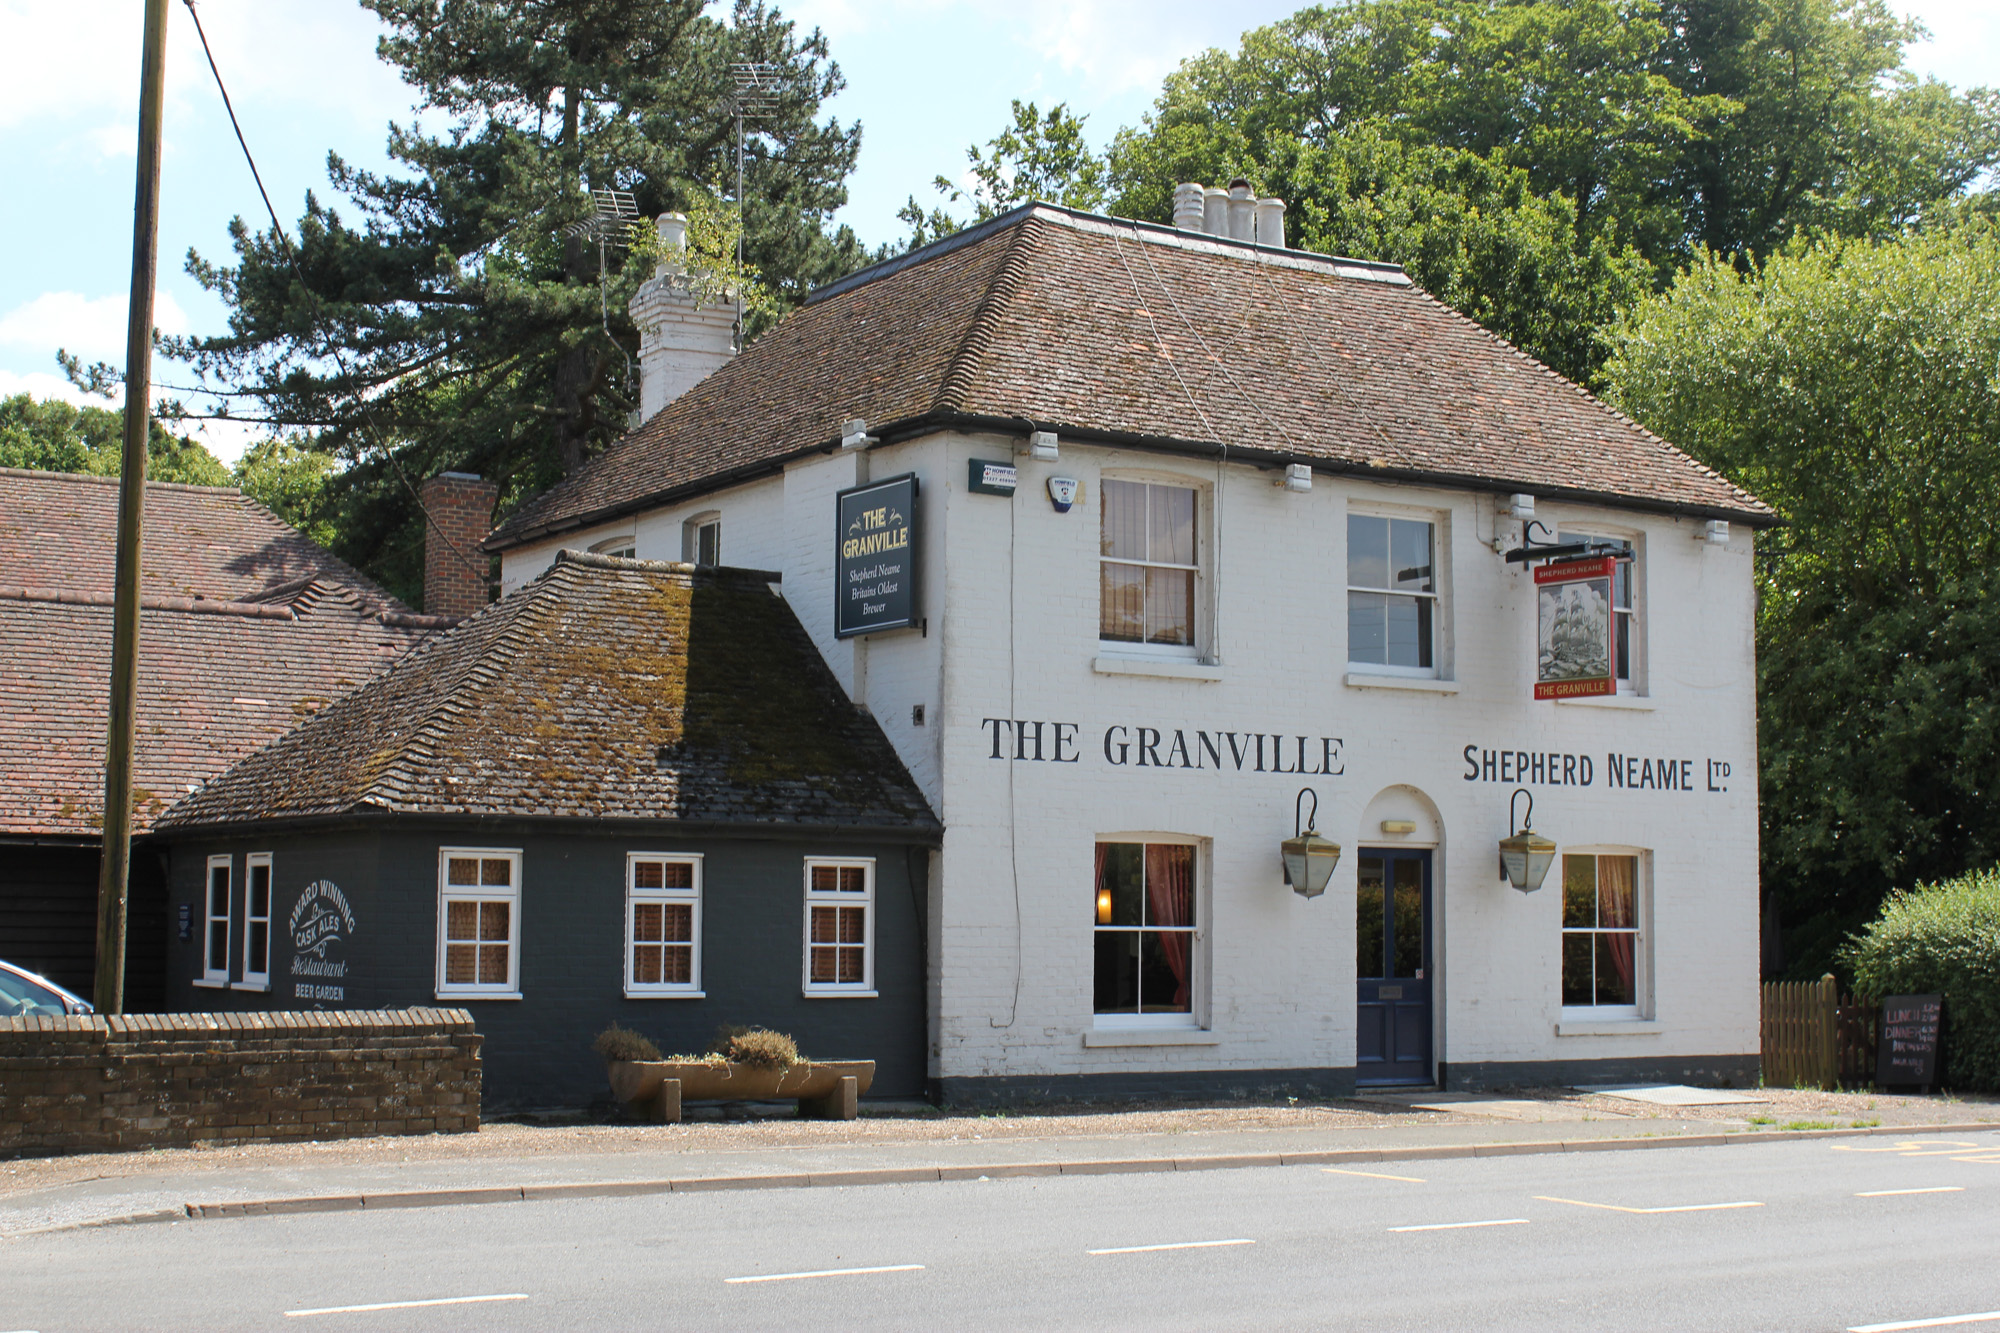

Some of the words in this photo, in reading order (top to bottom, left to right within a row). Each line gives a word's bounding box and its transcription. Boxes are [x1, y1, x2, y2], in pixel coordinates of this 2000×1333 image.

[863, 506, 887, 531] THE
[843, 526, 909, 560] GRANVILLE
[849, 566, 878, 584] Shepherd
[878, 563, 901, 577] Neame
[1539, 567, 1577, 578] SHEPHERD
[1578, 564, 1603, 573] NEAME
[851, 585, 877, 601] Britains
[877, 581, 898, 596] Oldest
[862, 602, 886, 616] Brewer
[1538, 685, 1555, 696] THE
[1556, 682, 1605, 695] GRANVILLE
[981, 717, 1080, 763] THE
[1103, 725, 1345, 775] GRANVILLE
[1463, 744, 1593, 787] SHEPHERD
[1608, 753, 1693, 791] NEAME
[289, 881, 319, 938] AWARD
[319, 879, 356, 935] WINNING
[296, 928, 317, 948] CASK
[318, 915, 340, 935] ALES
[291, 955, 346, 978] Restaurant
[295, 983, 315, 999] BEER
[315, 985, 344, 1001] GARDEN
[1886, 1009, 1920, 1024] LUNCH
[1885, 1026, 1921, 1040] DINNER
